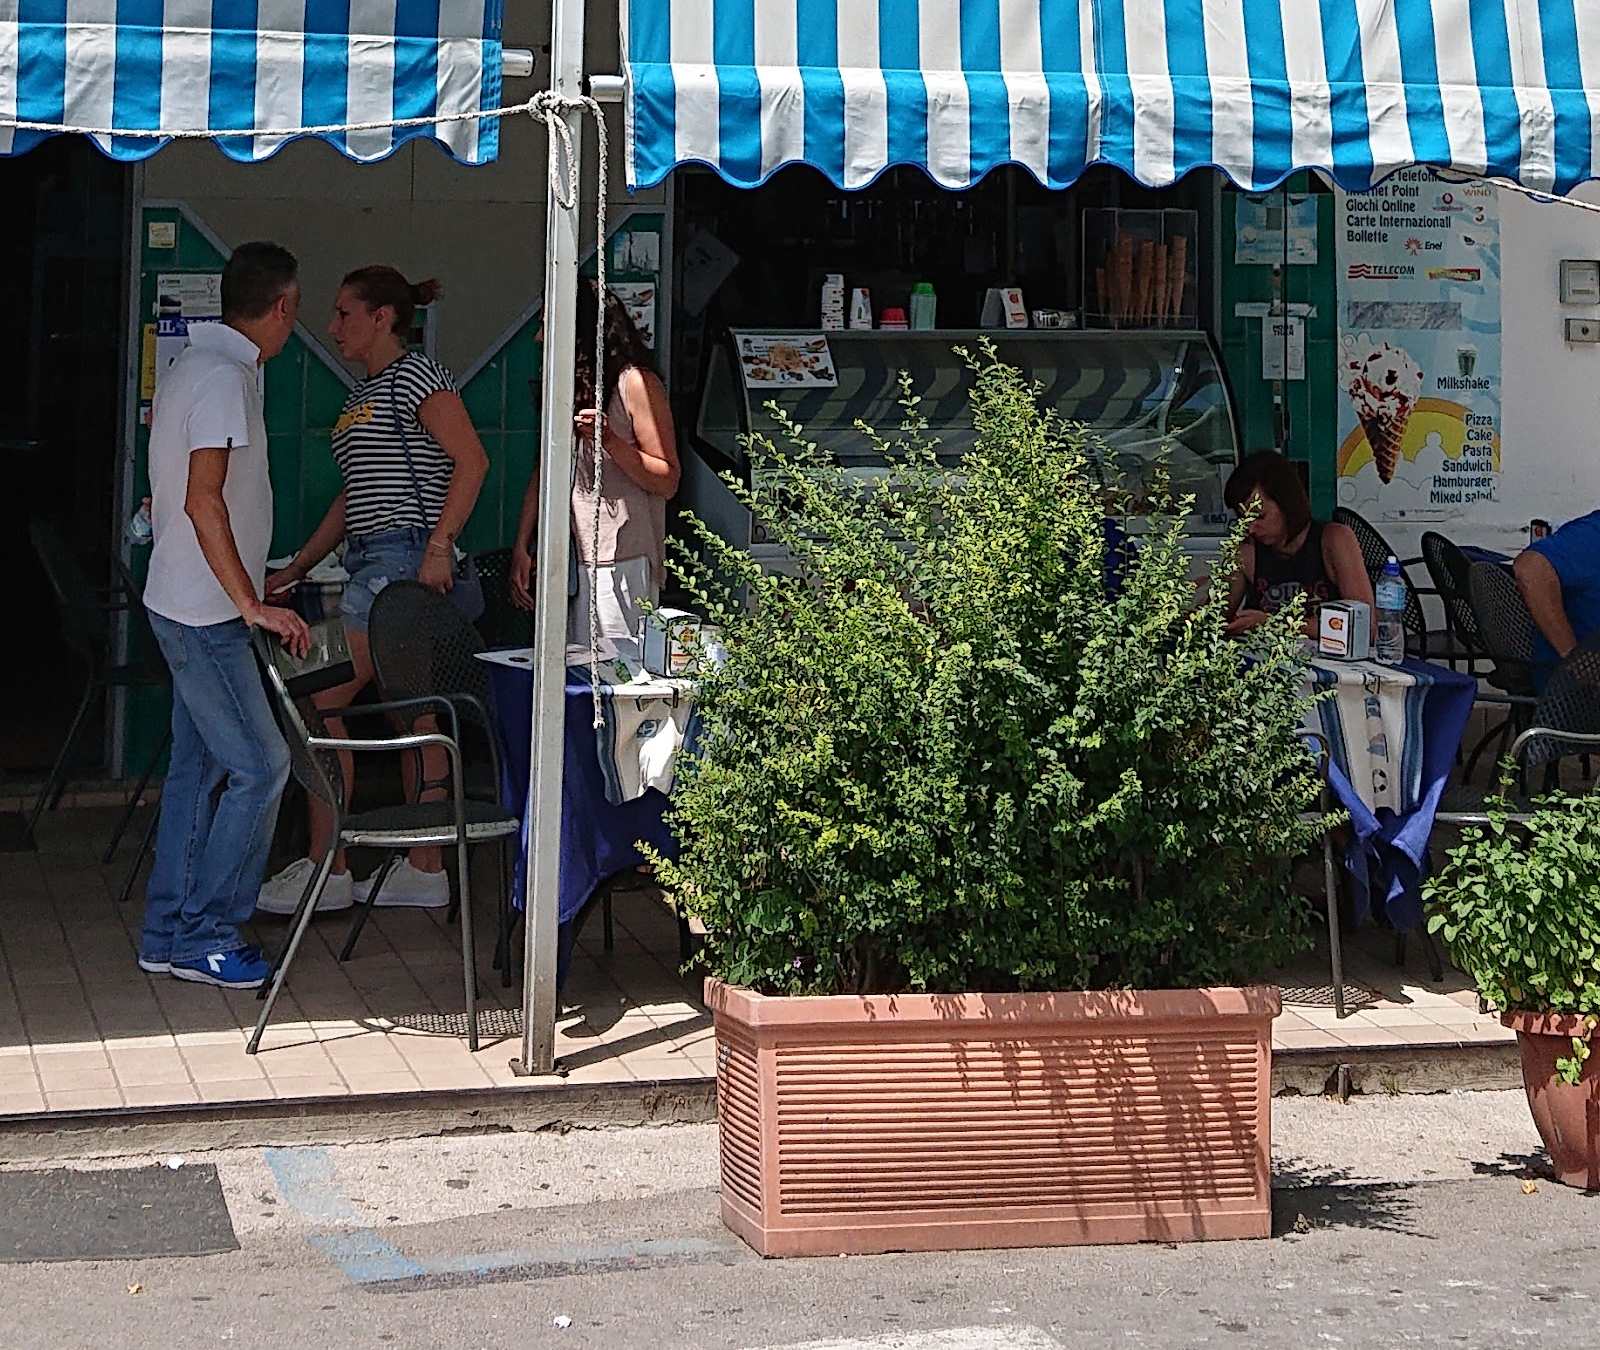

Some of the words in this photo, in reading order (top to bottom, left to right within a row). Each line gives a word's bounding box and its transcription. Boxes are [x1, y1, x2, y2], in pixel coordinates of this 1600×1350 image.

[1392, 185, 1419, 197] Point
[1462, 189, 1492, 197] WIND
[1346, 199, 1379, 212] Giochi
[1381, 199, 1416, 213] Online
[1346, 215, 1376, 228] Carte
[1379, 215, 1452, 228] Internazionali
[1346, 230, 1389, 243] Bollette
[1424, 241, 1443, 250] Enel
[1372, 265, 1415, 275] TELECOM
[1437, 377, 1490, 390] Milkshake
[1465, 414, 1492, 426] Pizza
[1466, 429, 1492, 441] Cake
[1462, 444, 1492, 457] Pasta
[1442, 460, 1492, 472] Sandwich
[1433, 475, 1493, 489] Hamburger
[1430, 490, 1462, 504] Mixed
